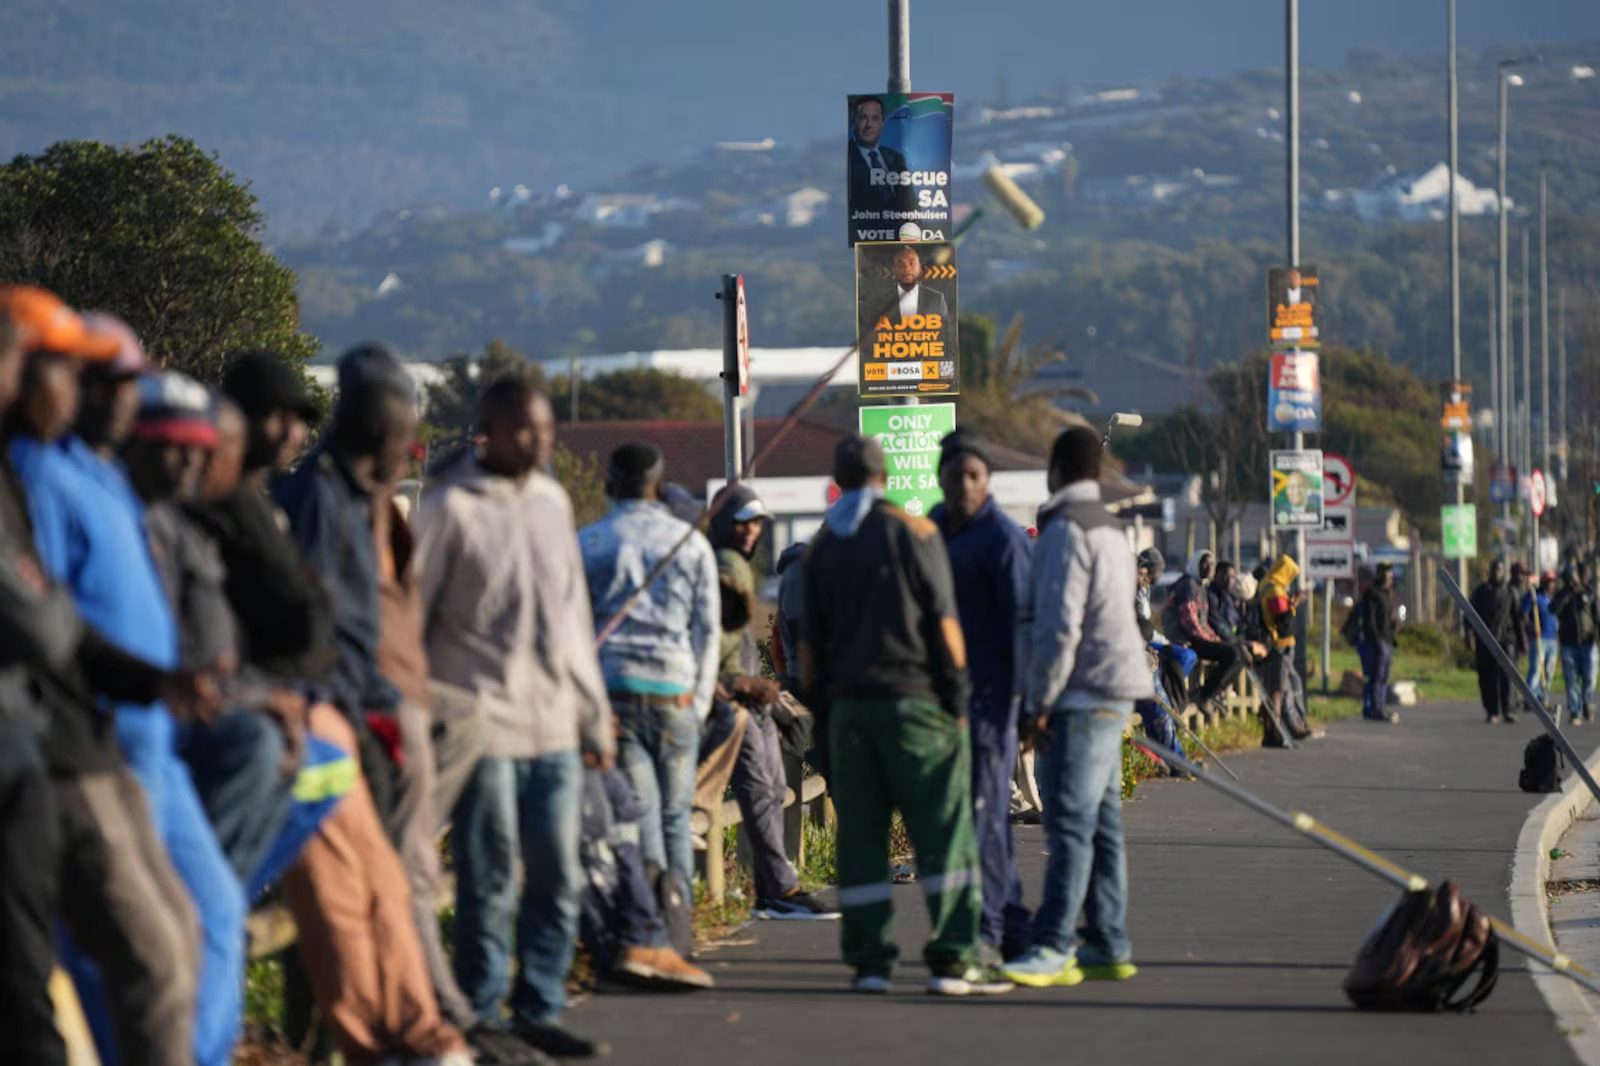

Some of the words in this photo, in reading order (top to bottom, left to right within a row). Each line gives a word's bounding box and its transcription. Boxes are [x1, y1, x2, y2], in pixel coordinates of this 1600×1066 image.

[870, 168, 948, 186] Rescue
[918, 189, 948, 208] SA
[852, 210, 880, 220] John
[882, 209, 948, 220] Steenhuisen
[857, 229, 895, 240] VOTE
[922, 229, 945, 241] DA
[874, 315, 892, 331] A
[894, 314, 943, 330] JOB
[878, 332, 892, 342] IN
[894, 331, 940, 342] EVERY
[873, 342, 944, 358] HOME
[866, 368, 886, 376] VOTE
[888, 415, 933, 430] ONLY
[881, 435, 941, 449] ACTION
[894, 455, 932, 469] WILL
[887, 475, 913, 490] FIX
[919, 474, 939, 489] SA
